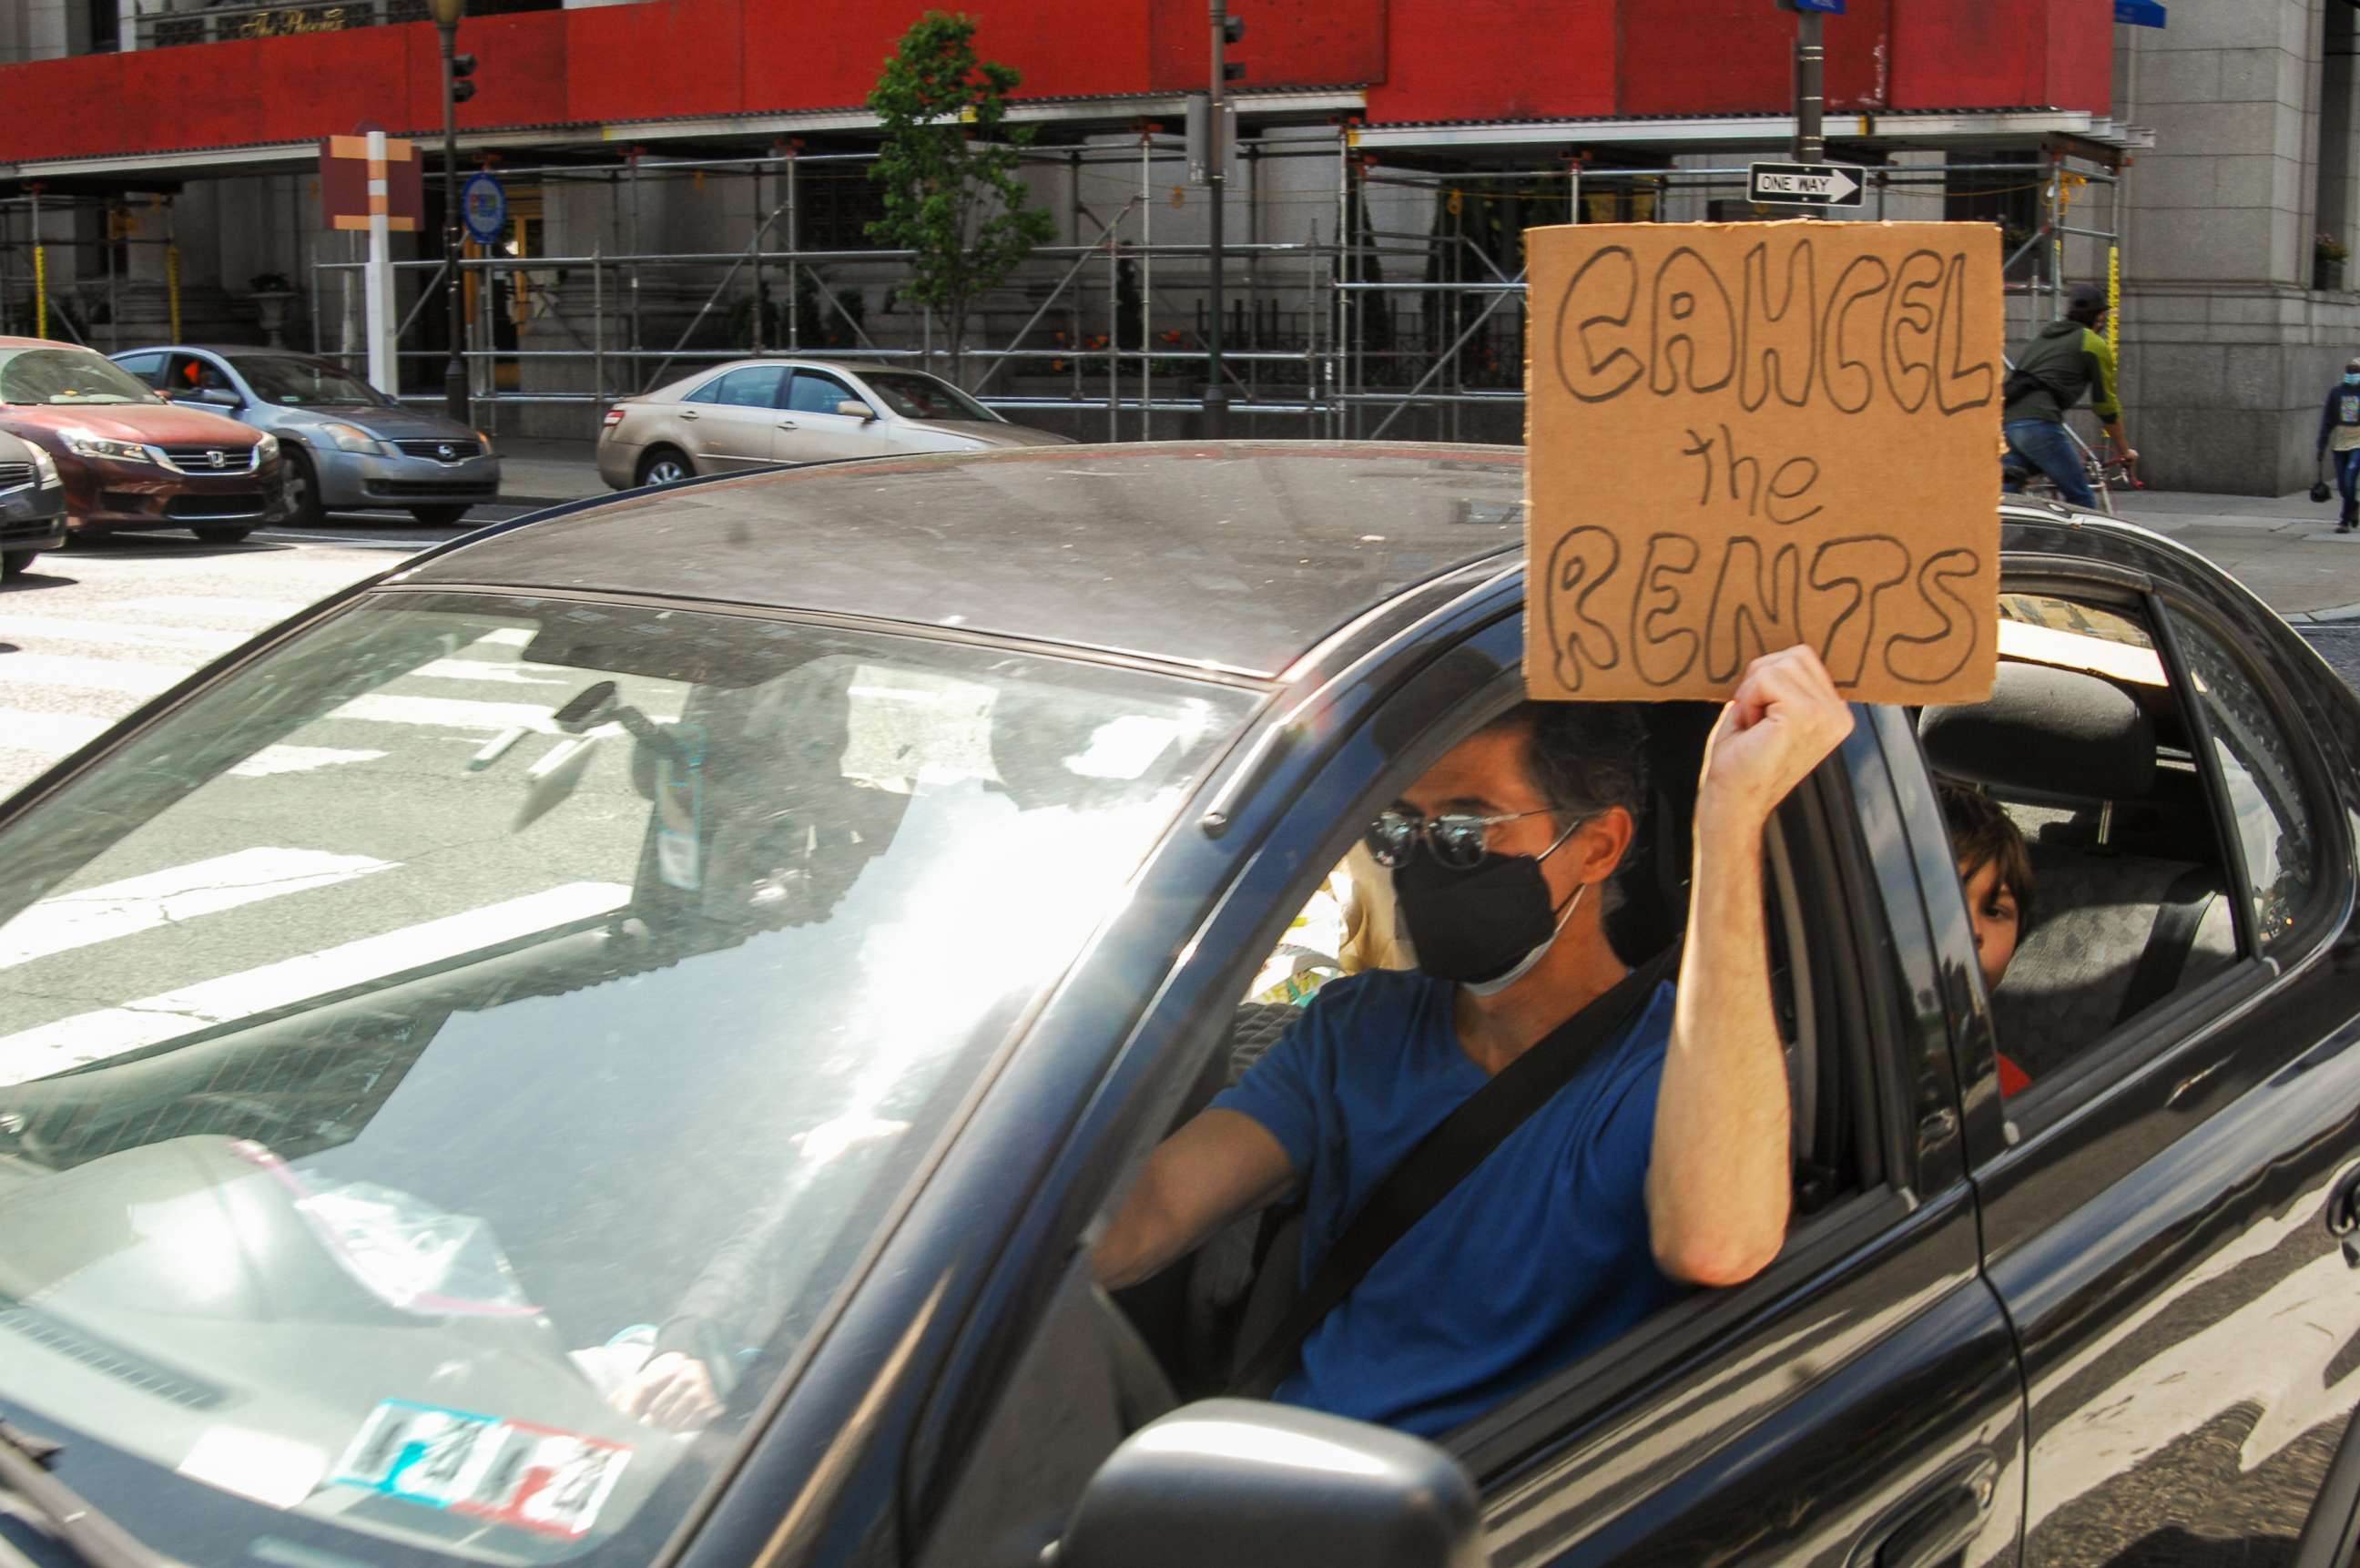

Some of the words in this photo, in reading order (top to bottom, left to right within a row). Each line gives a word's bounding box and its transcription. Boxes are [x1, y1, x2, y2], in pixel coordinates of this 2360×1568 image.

[1762, 176, 1792, 191] ONE
[1799, 177, 1830, 192] WAY
[1556, 239, 1994, 416] CANCEL
[1681, 423, 1824, 524] the
[1548, 524, 1980, 692] RENTS
